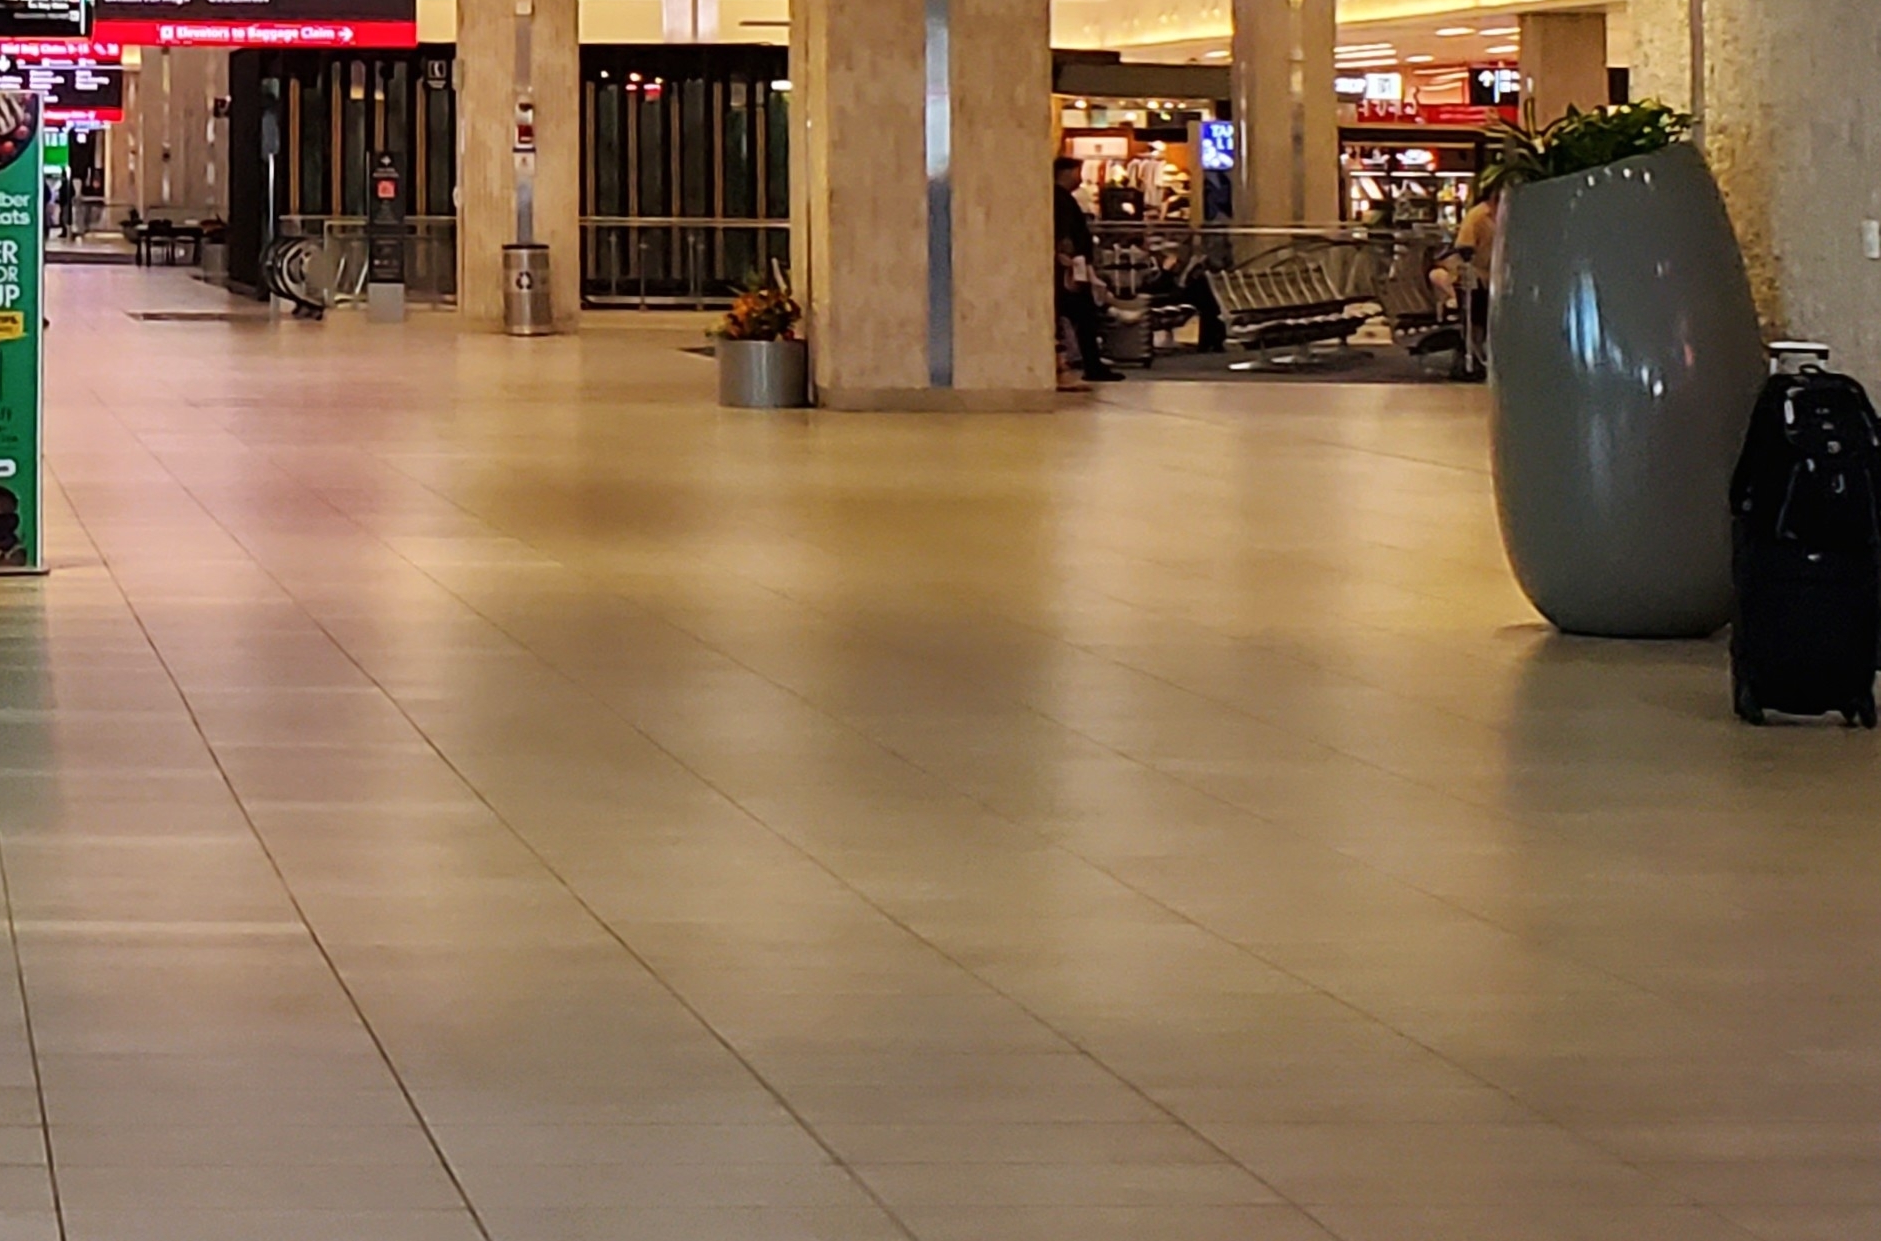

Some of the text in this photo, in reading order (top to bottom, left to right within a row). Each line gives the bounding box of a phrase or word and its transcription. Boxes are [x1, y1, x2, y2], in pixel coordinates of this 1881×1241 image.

[176, 26, 335, 43] Elevators to Baggage Claim
